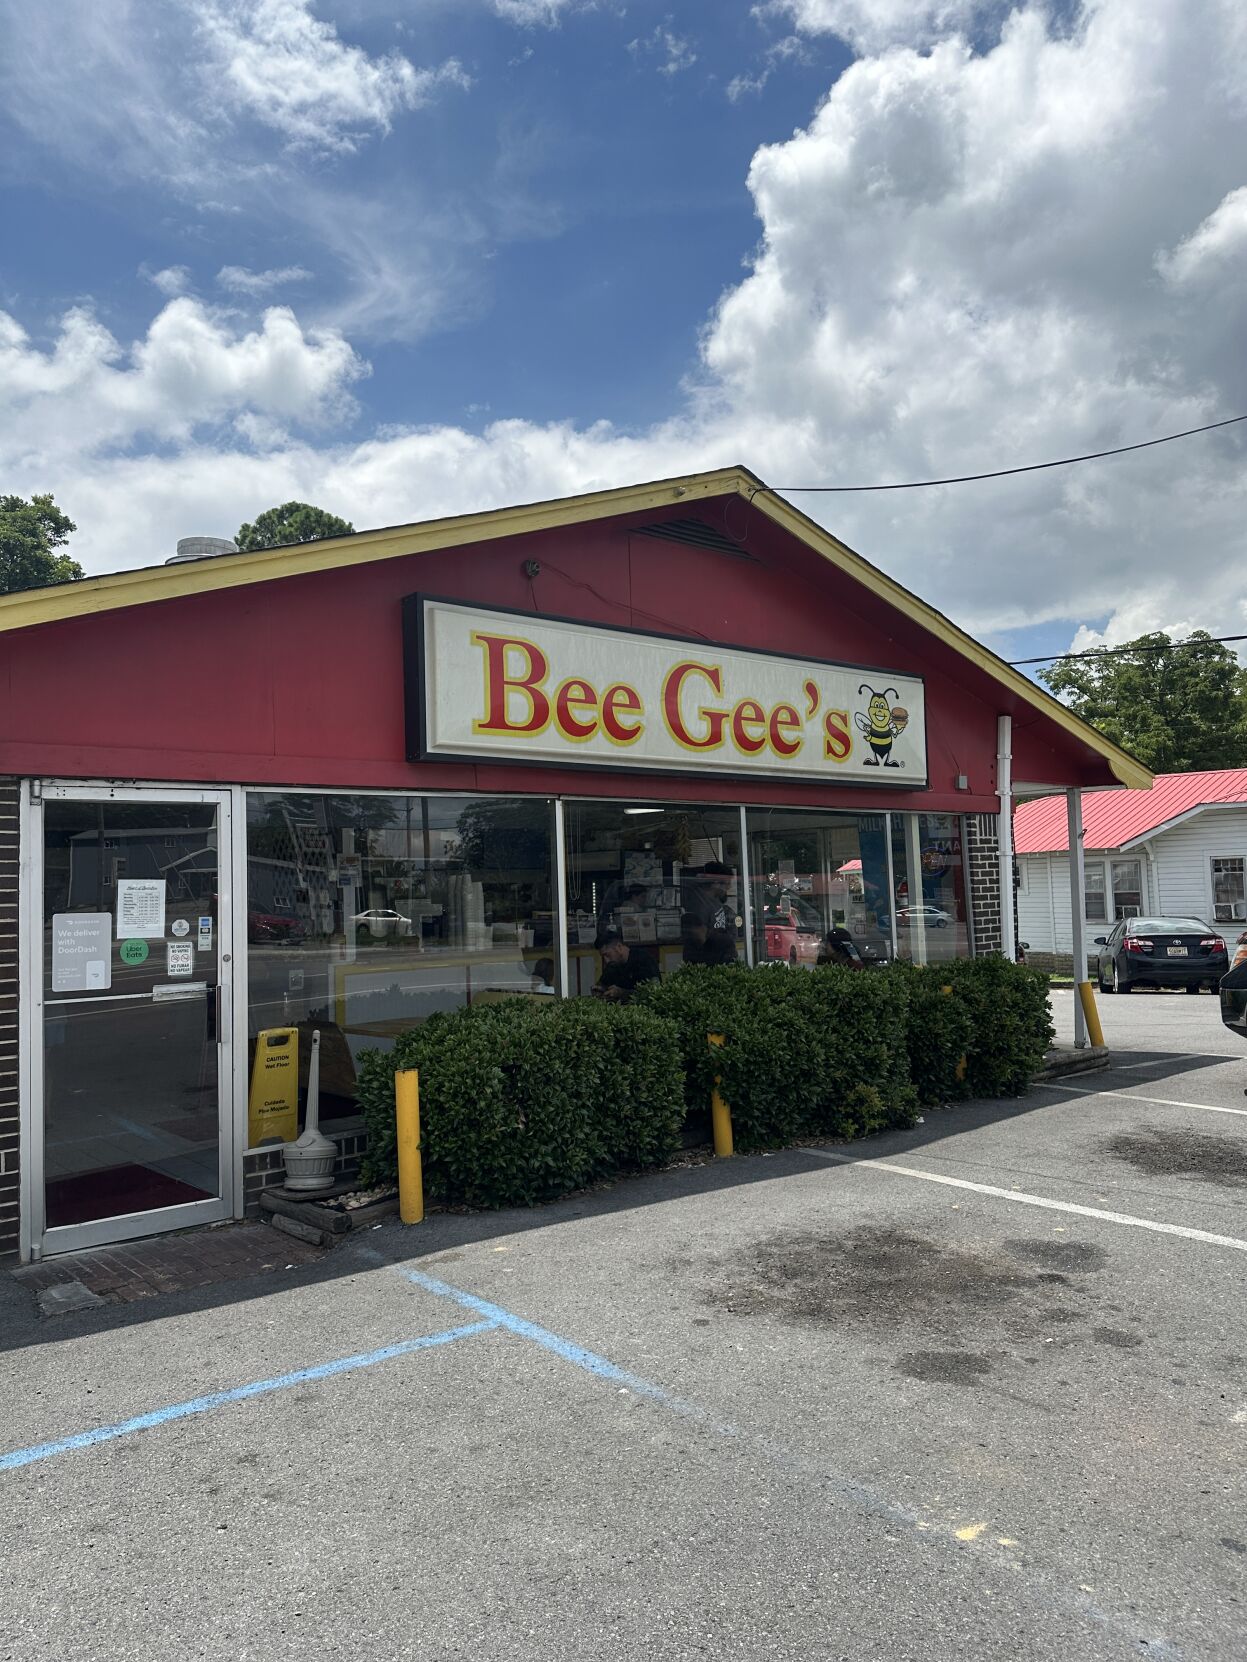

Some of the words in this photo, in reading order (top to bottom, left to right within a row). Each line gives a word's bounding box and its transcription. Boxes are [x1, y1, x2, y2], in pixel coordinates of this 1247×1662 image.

[471, 631, 644, 746] Bee
[661, 661, 852, 763] Gee's
[57, 929, 72, 937] We
[73, 929, 100, 937] deliver
